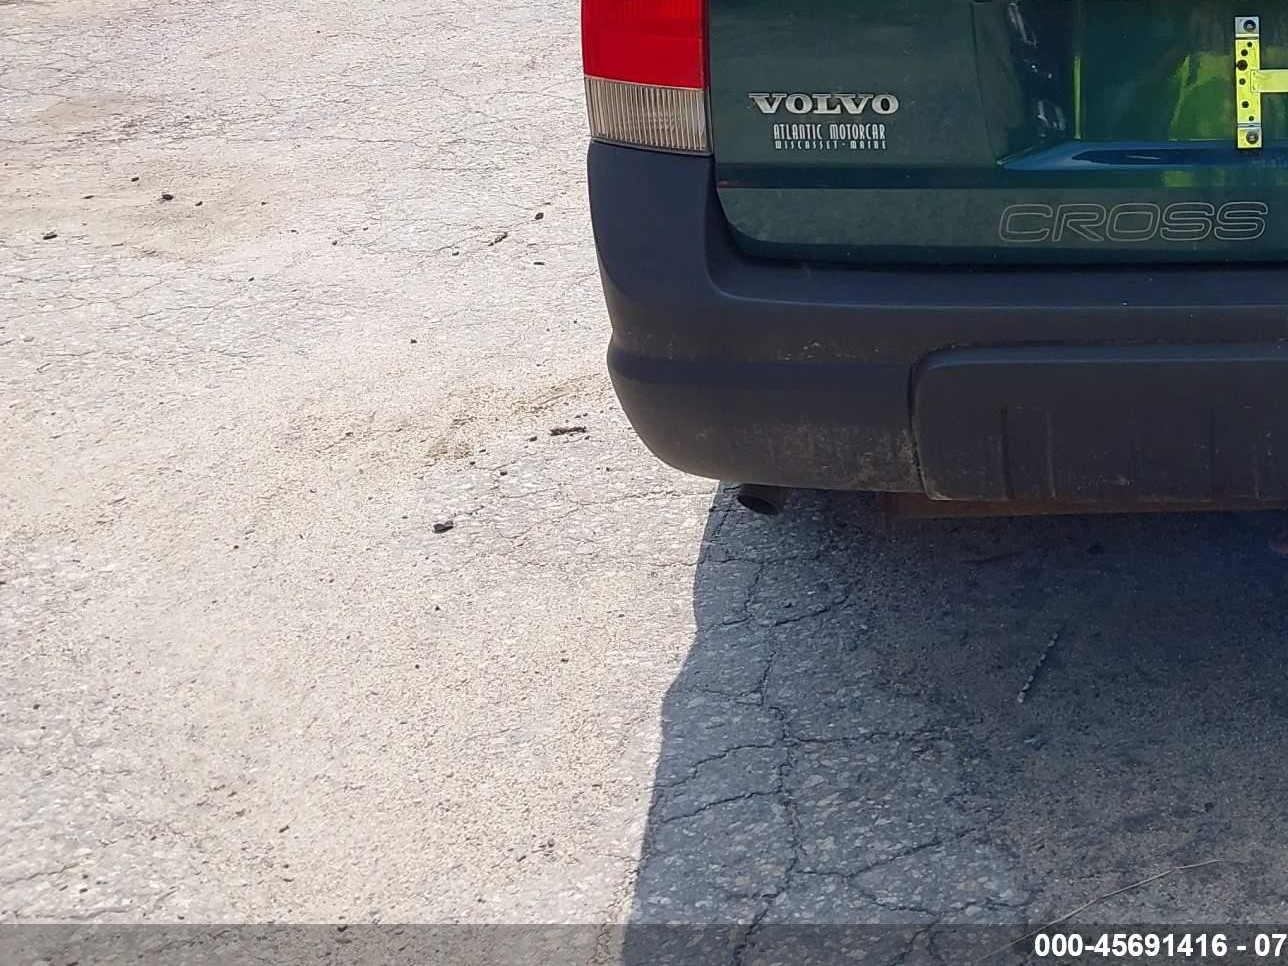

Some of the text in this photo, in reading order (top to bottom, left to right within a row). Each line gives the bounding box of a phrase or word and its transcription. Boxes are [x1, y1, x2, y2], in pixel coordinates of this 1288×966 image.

[748, 93, 900, 114] VOLVO
[773, 123, 887, 139] ATLANTIC MOTORCAR
[998, 202, 1269, 242] CROSS
